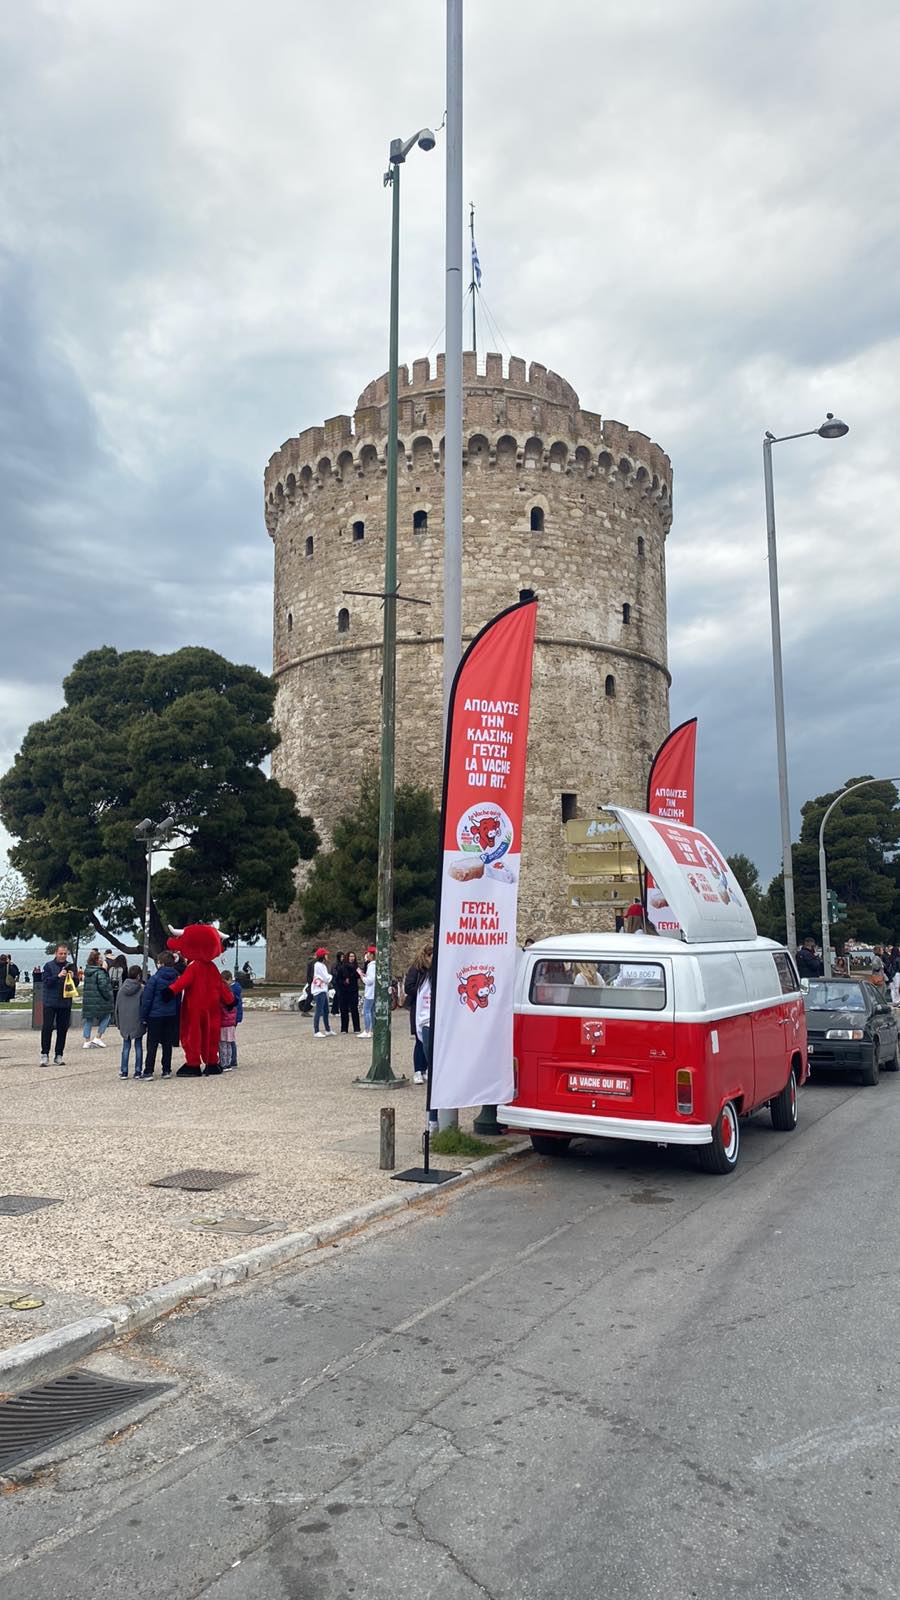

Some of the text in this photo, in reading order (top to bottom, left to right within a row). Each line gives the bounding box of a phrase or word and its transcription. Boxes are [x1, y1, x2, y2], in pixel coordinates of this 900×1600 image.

[464, 699, 519, 716] ΑΠΟΛΑΥΣΕ
[481, 715, 504, 728] ΤΗΝ
[467, 728, 513, 744] ΚΛΑΣΙΚΗ
[472, 744, 507, 758] ΓΕΥΣΗ
[465, 757, 511, 774] LA VACHE
[468, 773, 506, 788] QUI RIT.
[461, 901, 498, 917] ΓΕΥΣΗ,
[459, 916, 499, 930] ΜΙΑ ΚΑΙ
[446, 931, 508, 945] ΜΟΝΑΔΙΚΗ!
[461, 965, 478, 973] Vache
[569, 1076, 577, 1085] LA
[579, 1077, 600, 1087] VACHE
[602, 1079, 614, 1089] QUI
